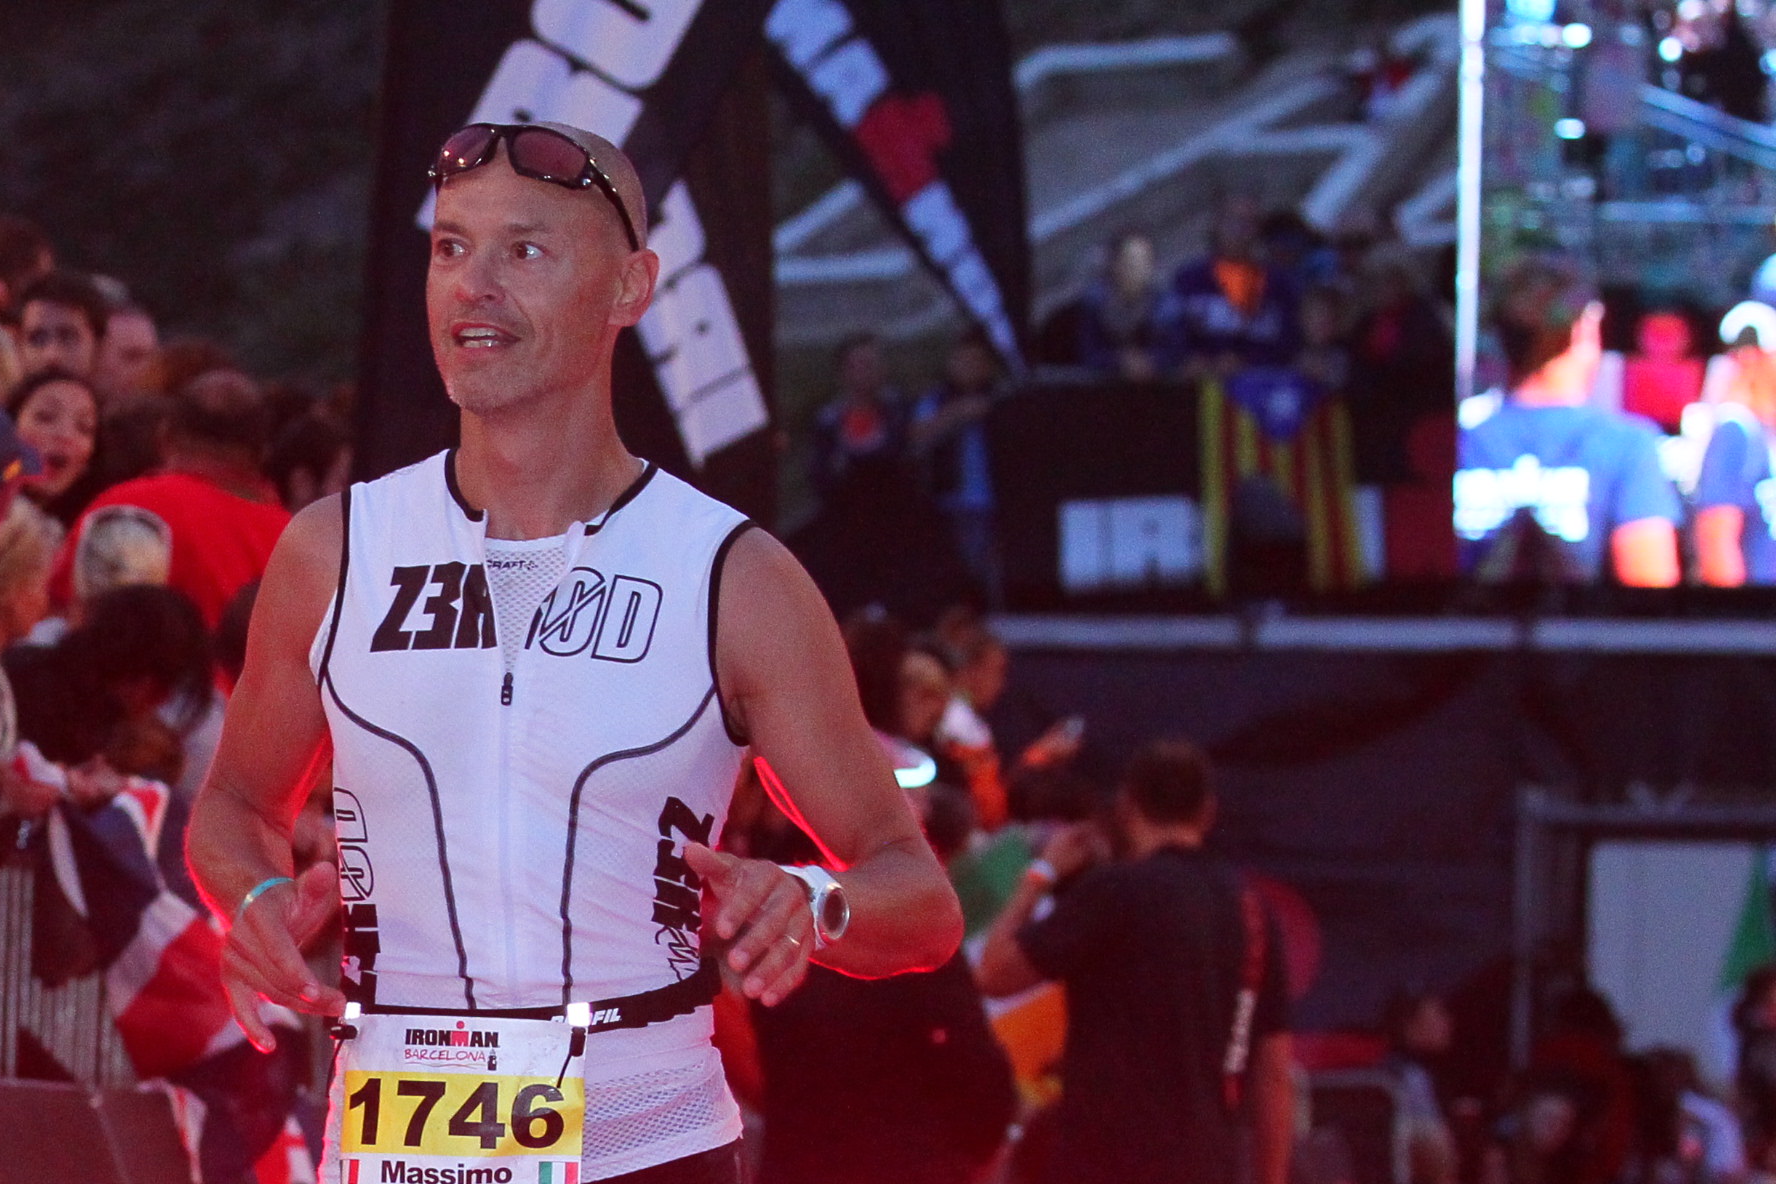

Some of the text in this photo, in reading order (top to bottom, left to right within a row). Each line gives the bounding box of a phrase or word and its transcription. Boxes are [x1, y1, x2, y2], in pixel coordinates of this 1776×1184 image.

[405, 1028, 500, 1048] IRONMAN
[404, 1049, 487, 1062] BARCELONA
[349, 1078, 565, 1150] 1746
